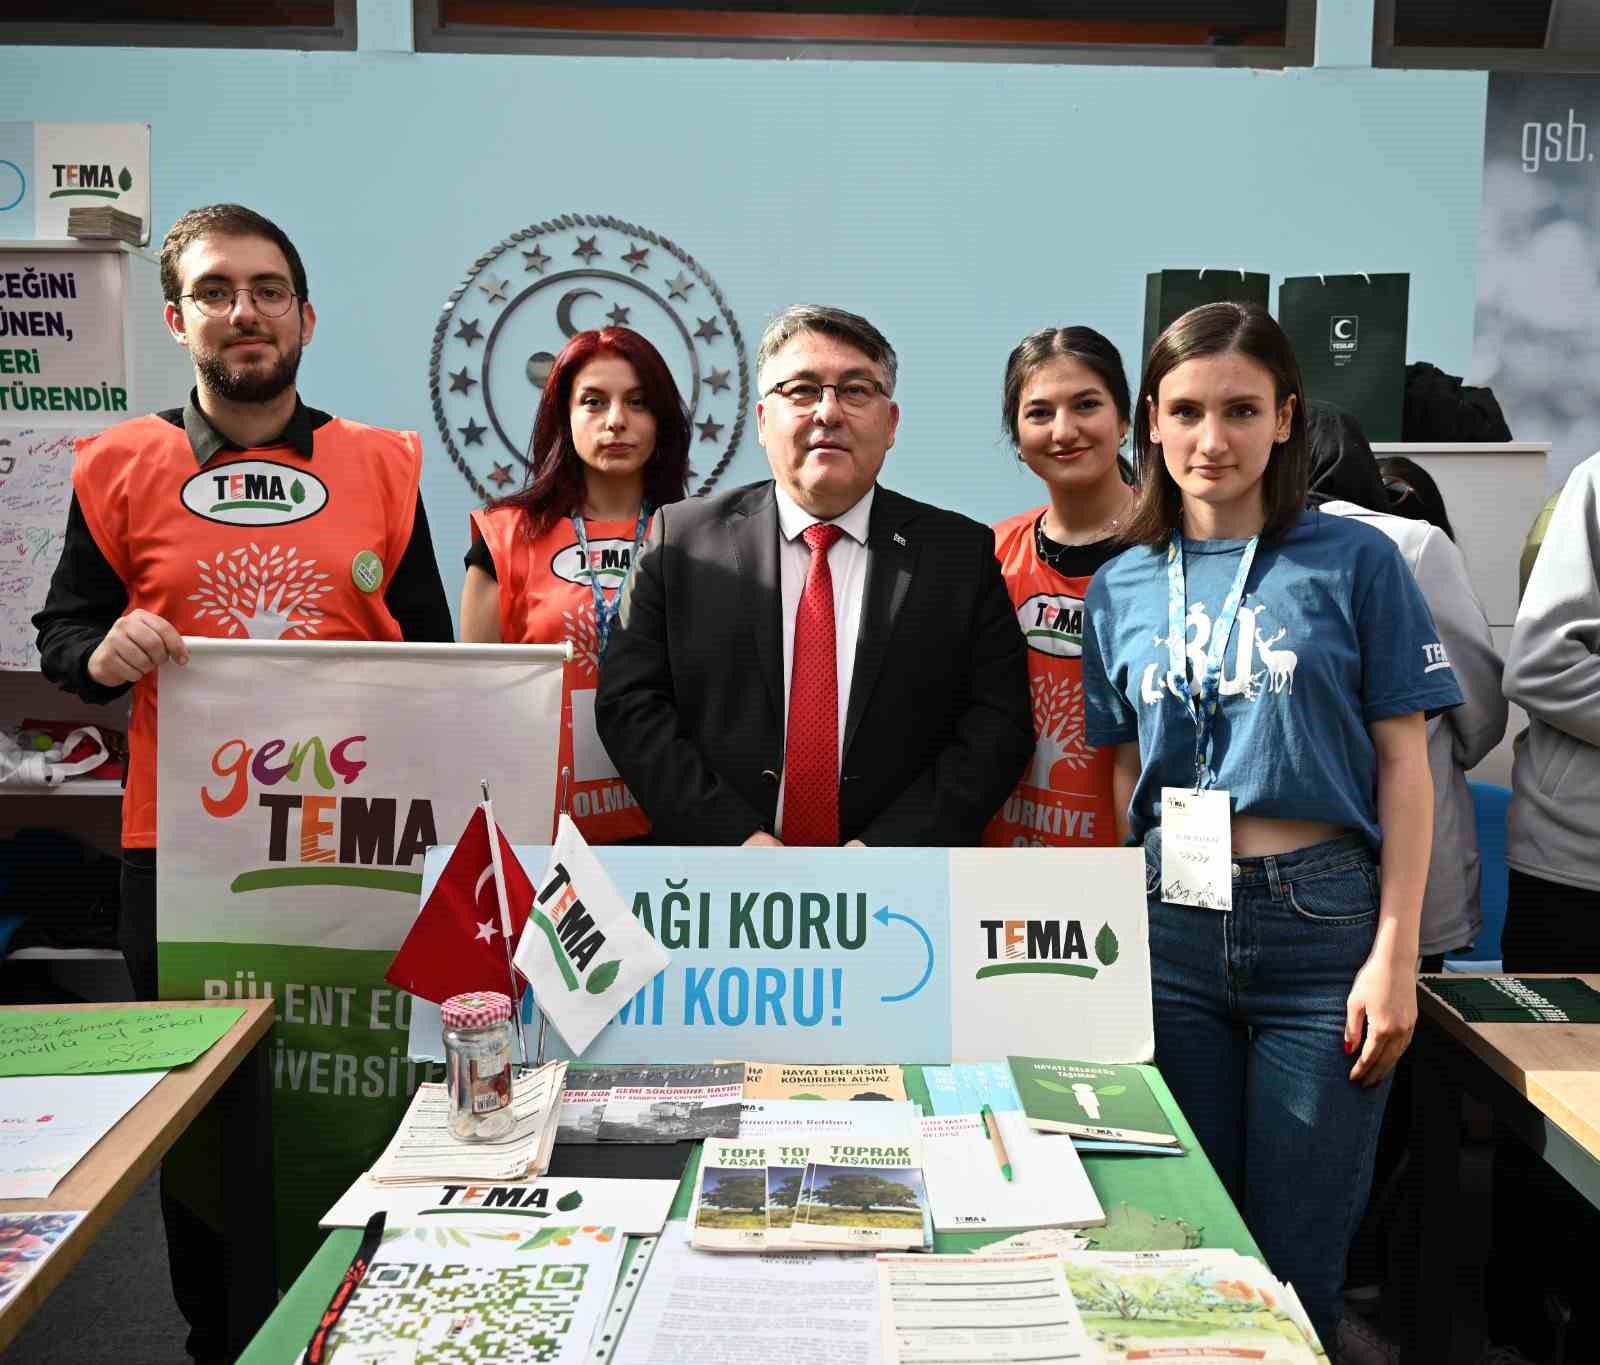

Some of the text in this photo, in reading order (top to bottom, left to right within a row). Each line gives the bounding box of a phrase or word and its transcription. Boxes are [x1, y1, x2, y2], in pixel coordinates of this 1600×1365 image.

[52, 164, 115, 188] TEMA
[213, 474, 287, 501] TEMA
[576, 548, 631, 570] TEMA
[1035, 602, 1082, 634] TEMA
[200, 735, 367, 819] genç
[259, 793, 438, 866] TEMA
[537, 862, 607, 973] TEMA
[729, 891, 868, 951] KORU
[980, 920, 1088, 960] TEMA
[684, 967, 844, 1028] KORU!
[779, 1147, 810, 1157] TO
[831, 1145, 910, 1157] TOPRAK
[829, 1156, 911, 1166] YAŞAMDIR
[439, 1185, 549, 1208] TEMA
